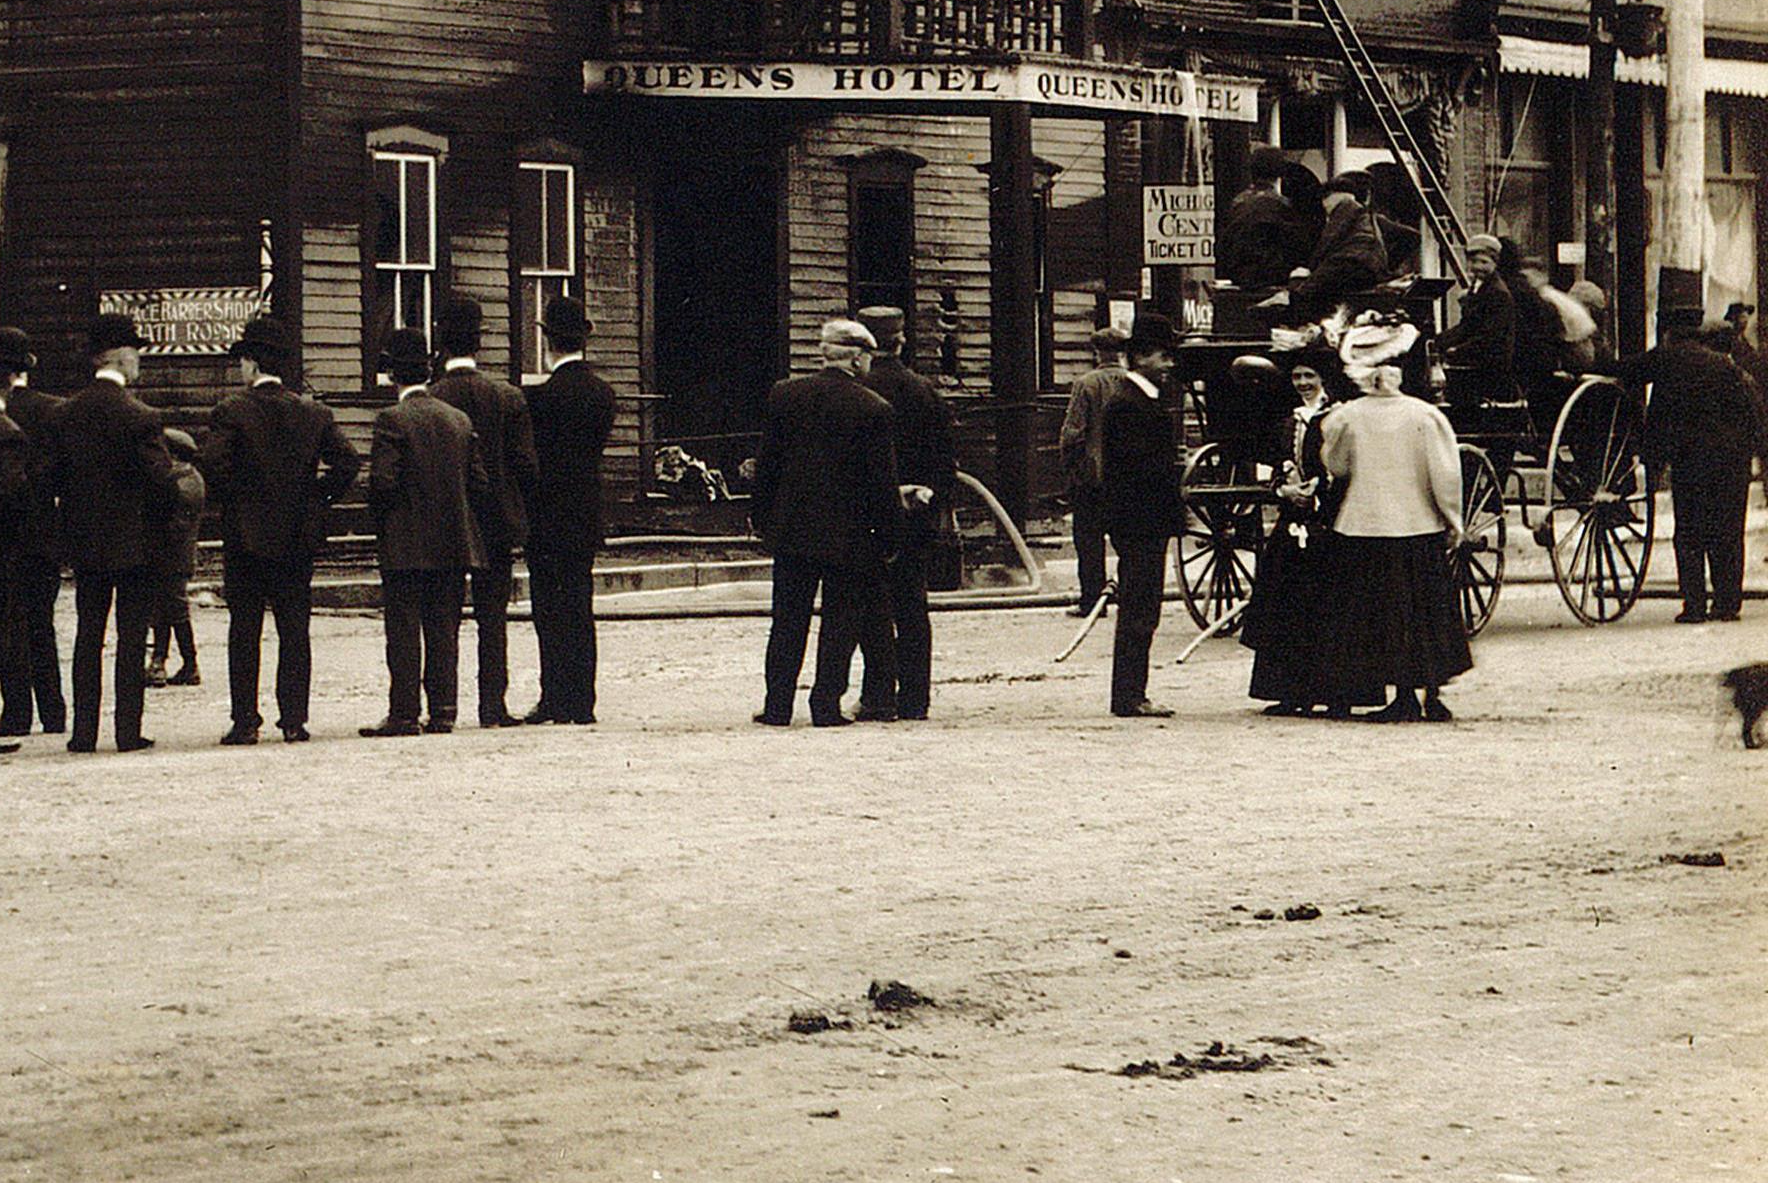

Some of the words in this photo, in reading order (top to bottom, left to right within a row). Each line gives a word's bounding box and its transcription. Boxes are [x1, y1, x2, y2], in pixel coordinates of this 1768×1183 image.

[604, 64, 795, 92] QUEENS
[832, 66, 1001, 93] HOTEL
[1037, 72, 1143, 103] QUEENS
[1147, 239, 1196, 258] TICKET
[161, 300, 212, 321] BARBER
[213, 300, 254, 320] SHOP
